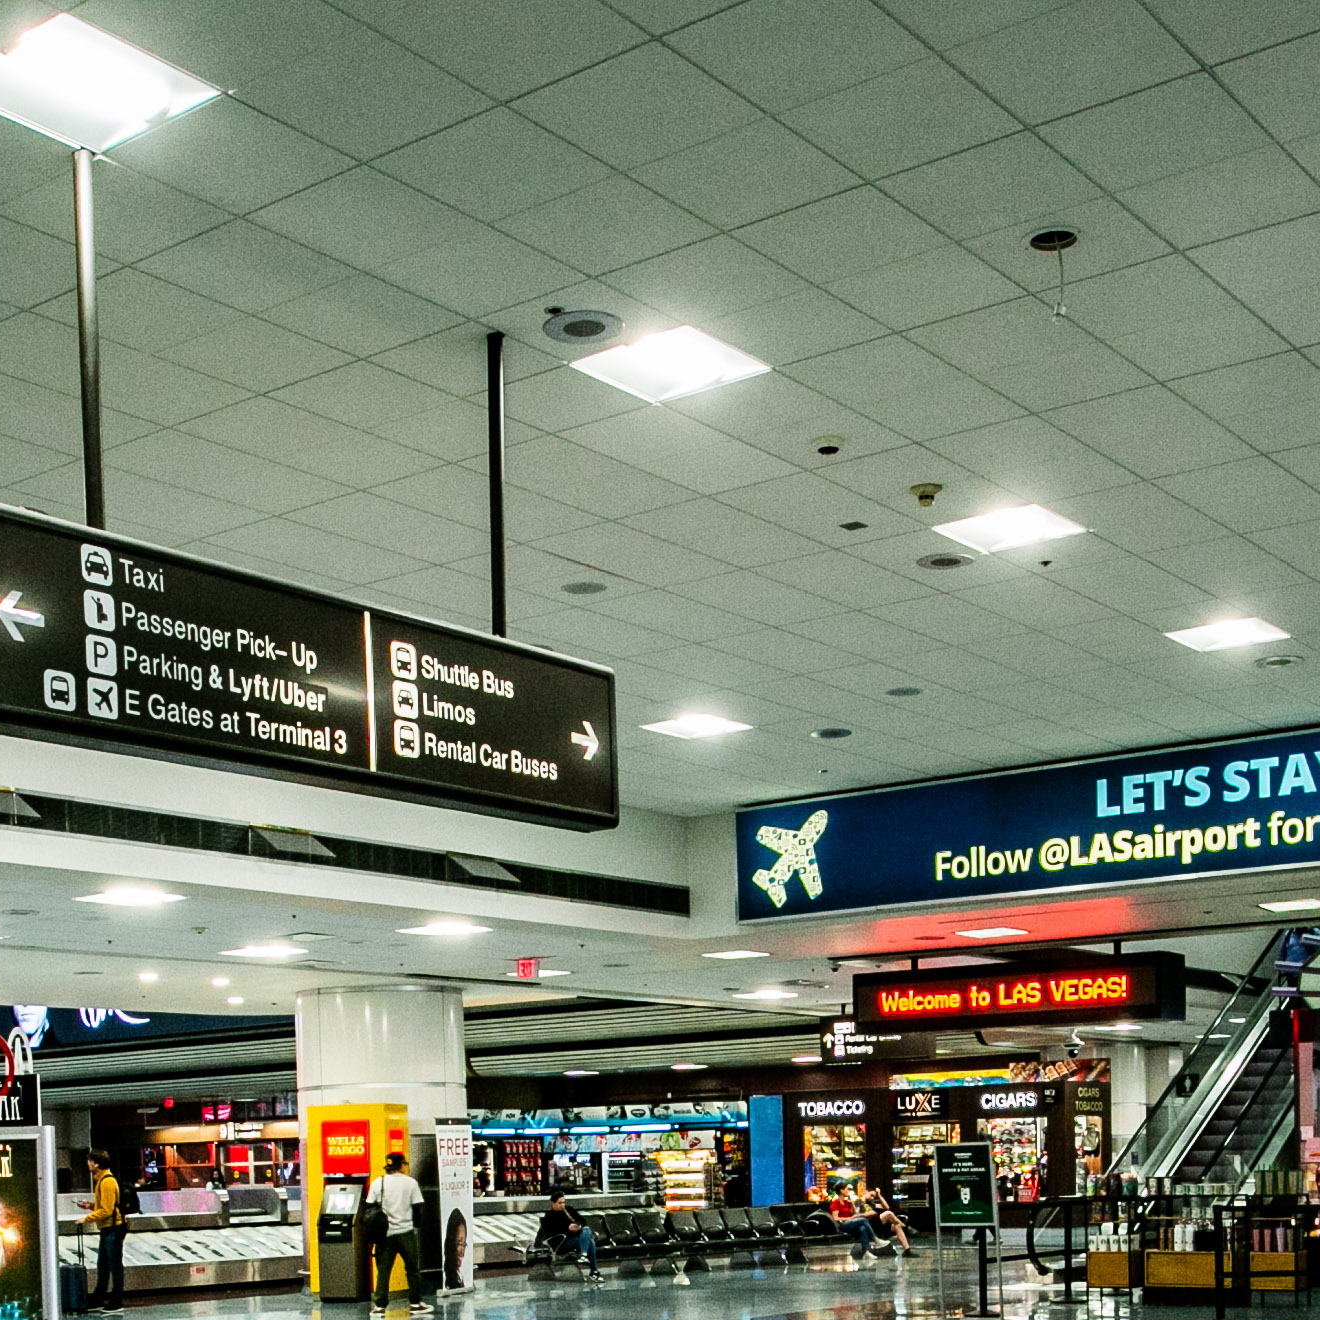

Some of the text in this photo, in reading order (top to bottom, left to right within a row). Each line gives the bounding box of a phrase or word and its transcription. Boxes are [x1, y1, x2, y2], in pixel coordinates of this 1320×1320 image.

[119, 558, 165, 592] Taxi
[121, 602, 231, 651] Passenger
[291, 641, 318, 675] Up
[123, 646, 326, 712] Parking & Lyft/Uber
[421, 655, 514, 698] Shuttle Bus
[125, 689, 347, 754] E Gates at Terminal 3
[423, 692, 475, 725] Limos
[424, 732, 557, 780] Rental Car Buses
[1096, 766, 1211, 817] LET'S
[935, 846, 1033, 880] Follow
[1038, 817, 1261, 870] @LASairport
[881, 975, 1128, 1013] Welcome to LAS VEGAS!
[897, 1093, 940, 1112] LUXE
[981, 1092, 1036, 1109] CIGARS
[1078, 1088, 1099, 1097] CIGARS
[798, 1100, 866, 1116] TOBACCO
[1075, 1101, 1103, 1111] TOBACCO
[328, 1137, 365, 1145] WELLS
[329, 1146, 364, 1155] FARGO
[439, 1138, 468, 1156] FREE
[442, 1158, 466, 1167] SAMPLES
[445, 1181, 466, 1190] LIQUOR
